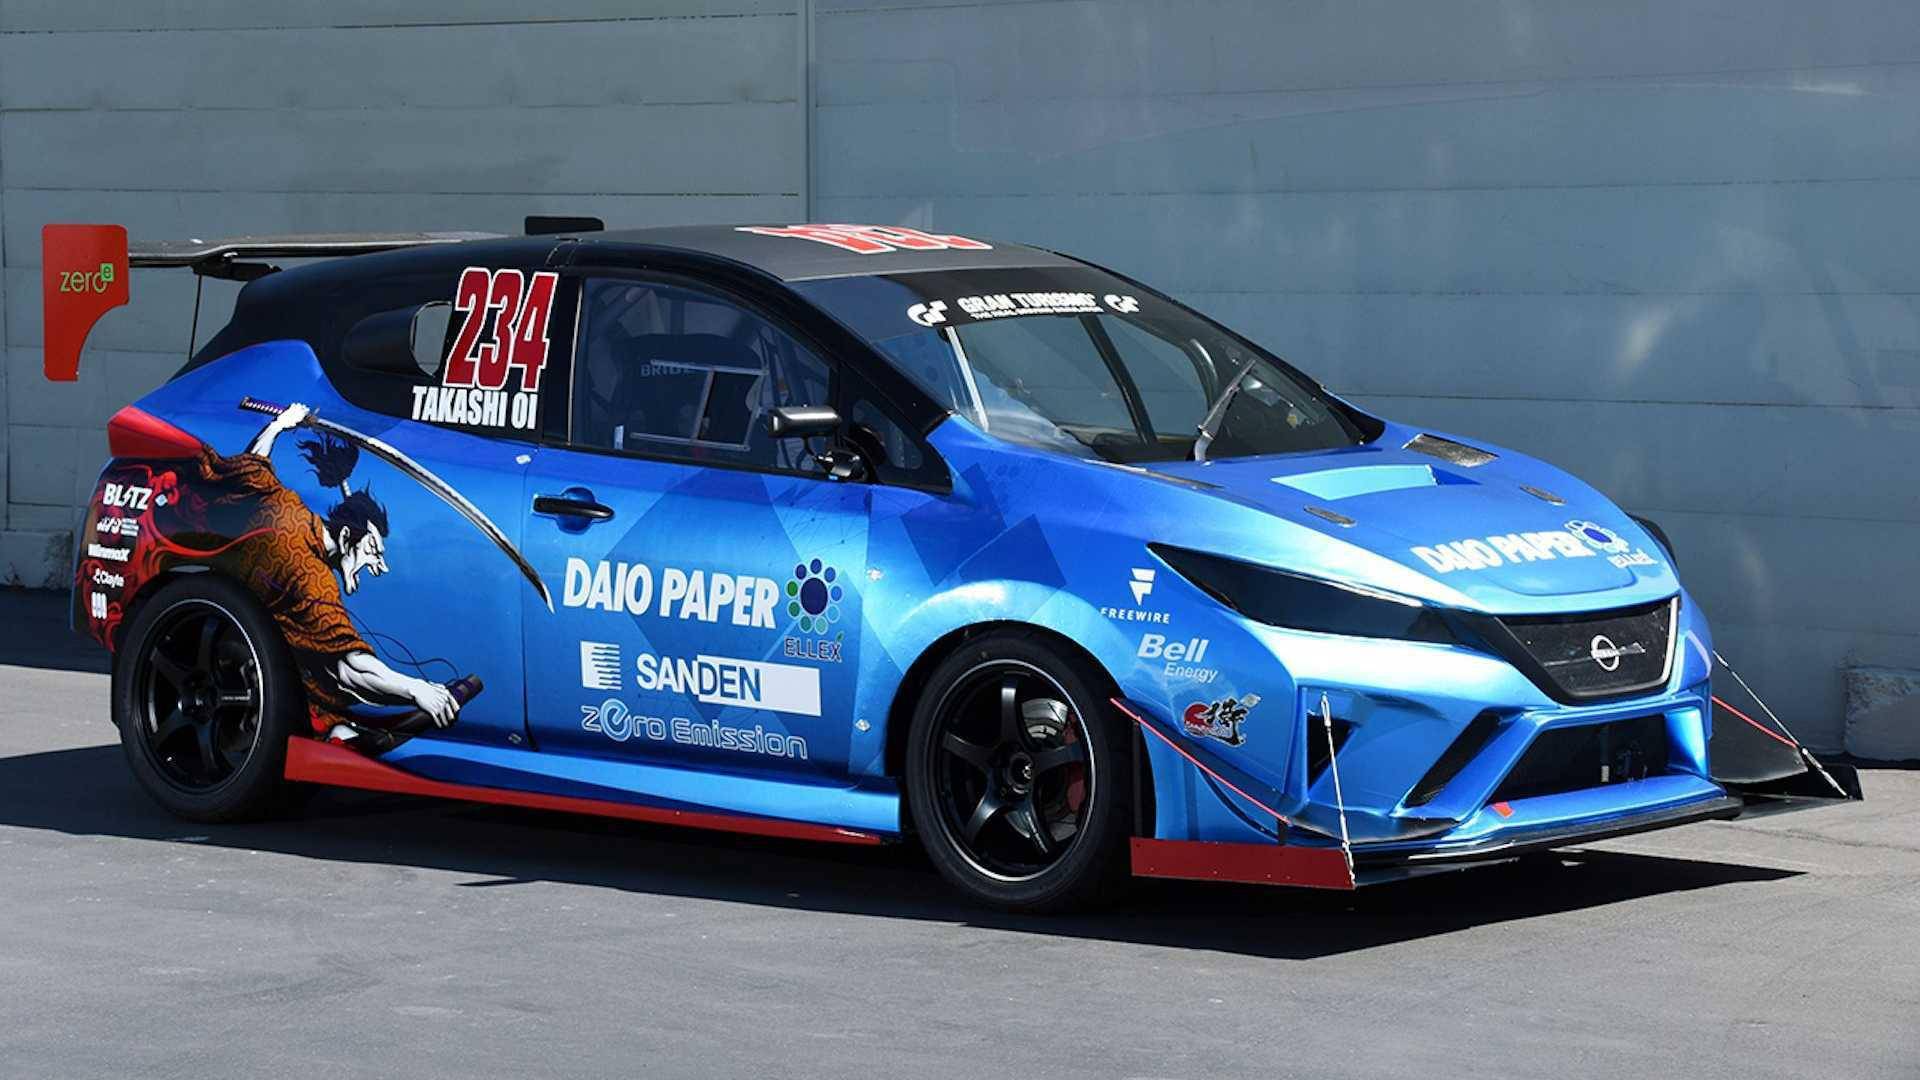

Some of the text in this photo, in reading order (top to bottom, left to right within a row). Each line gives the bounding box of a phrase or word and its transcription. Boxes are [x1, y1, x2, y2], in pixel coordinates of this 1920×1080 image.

[957, 295, 1016, 313] GRAN
[442, 266, 559, 392] 234
[411, 385, 539, 430] TAKASHI OI
[1410, 530, 1597, 575] DAIO PAPER
[563, 557, 780, 630] DAIO PAPER
[1099, 607, 1171, 625] FREEWIRE
[783, 635, 843, 663] ELLEX
[1137, 633, 1210, 664] Bell
[636, 653, 761, 702] SANDEN
[1163, 662, 1218, 684] Energy
[672, 719, 809, 760] Emission
